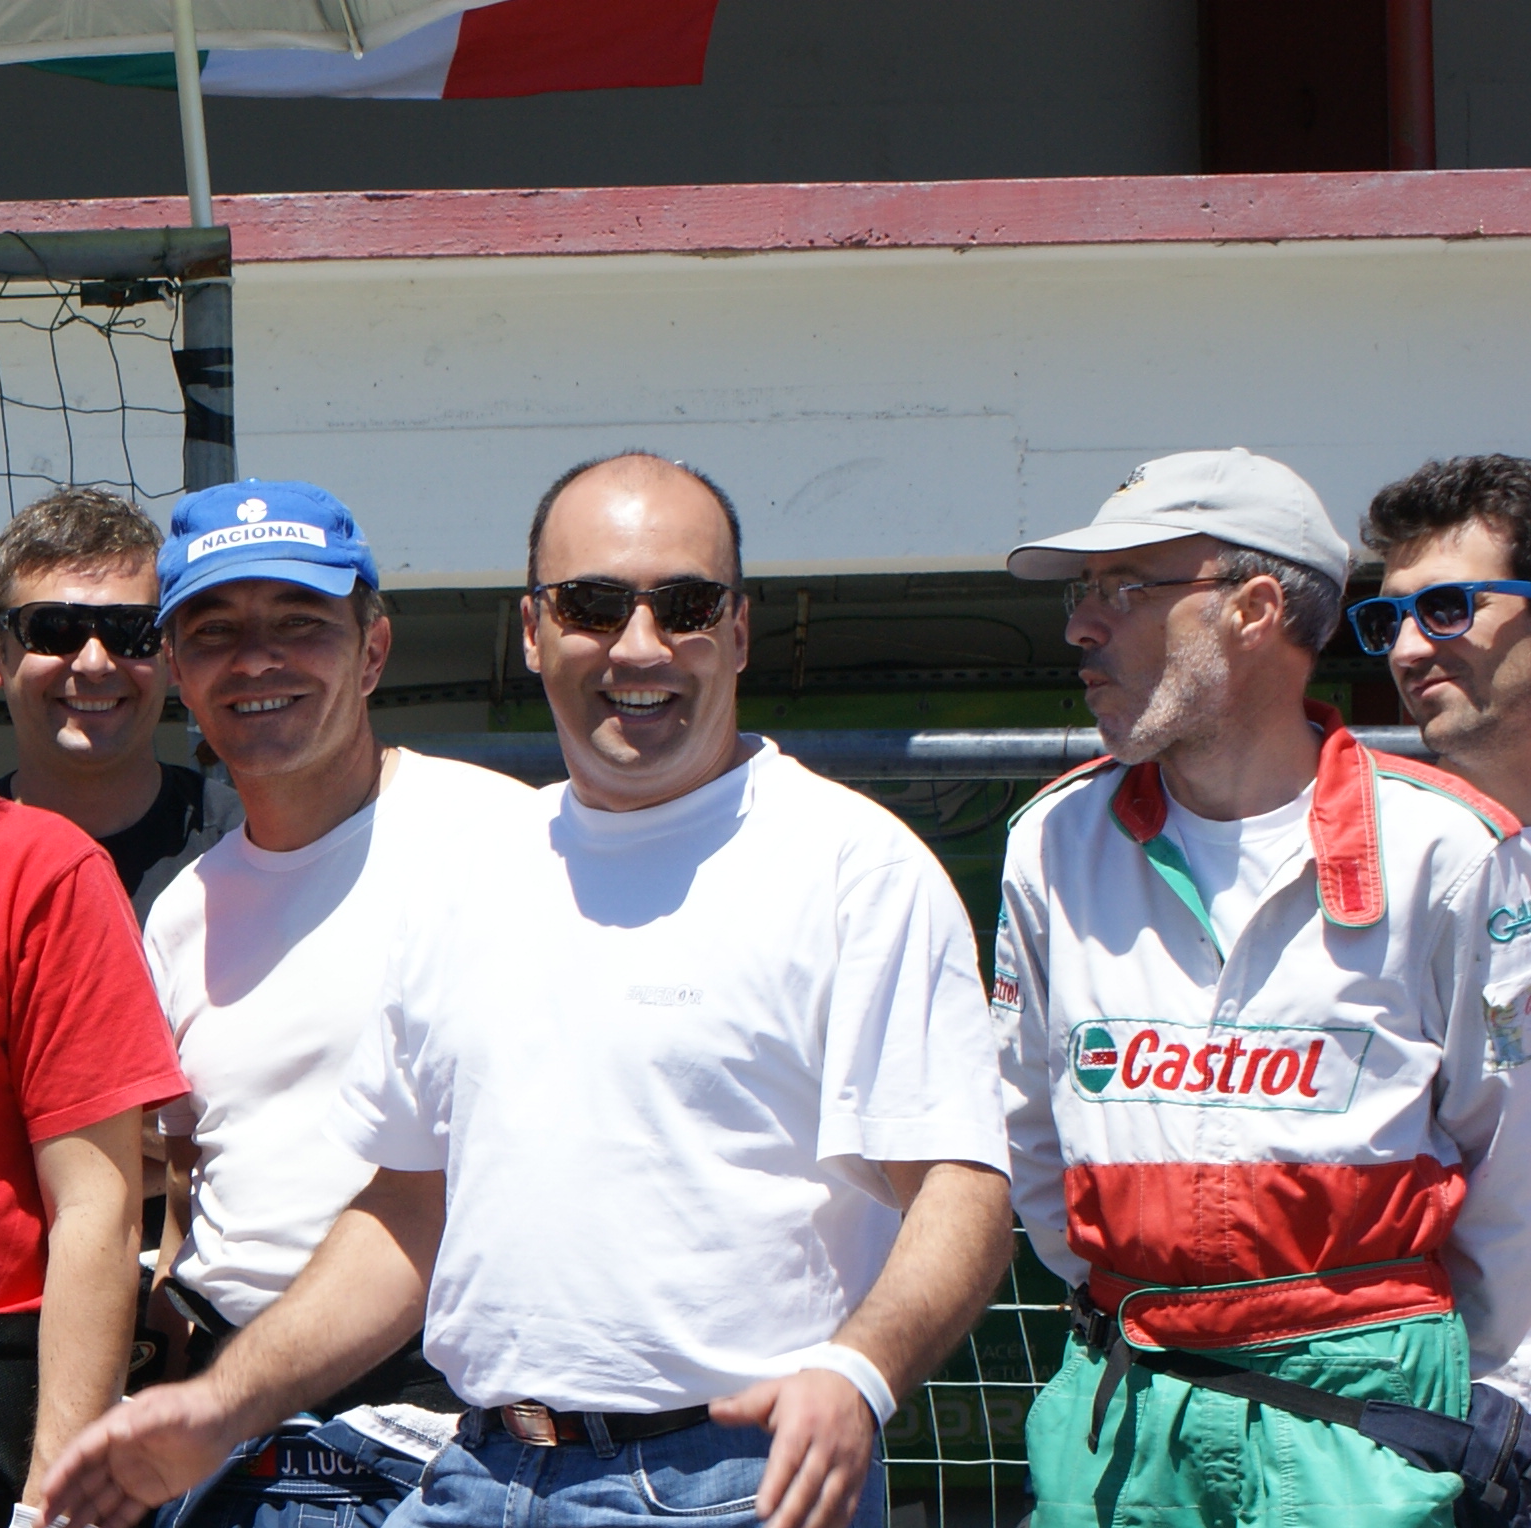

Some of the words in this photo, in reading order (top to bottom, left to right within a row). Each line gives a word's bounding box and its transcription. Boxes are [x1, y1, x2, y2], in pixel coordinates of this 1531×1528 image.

[202, 526, 310, 550] NACIONAL
[1121, 1028, 1325, 1098] Castrol
[281, 1450, 298, 1475] J.
